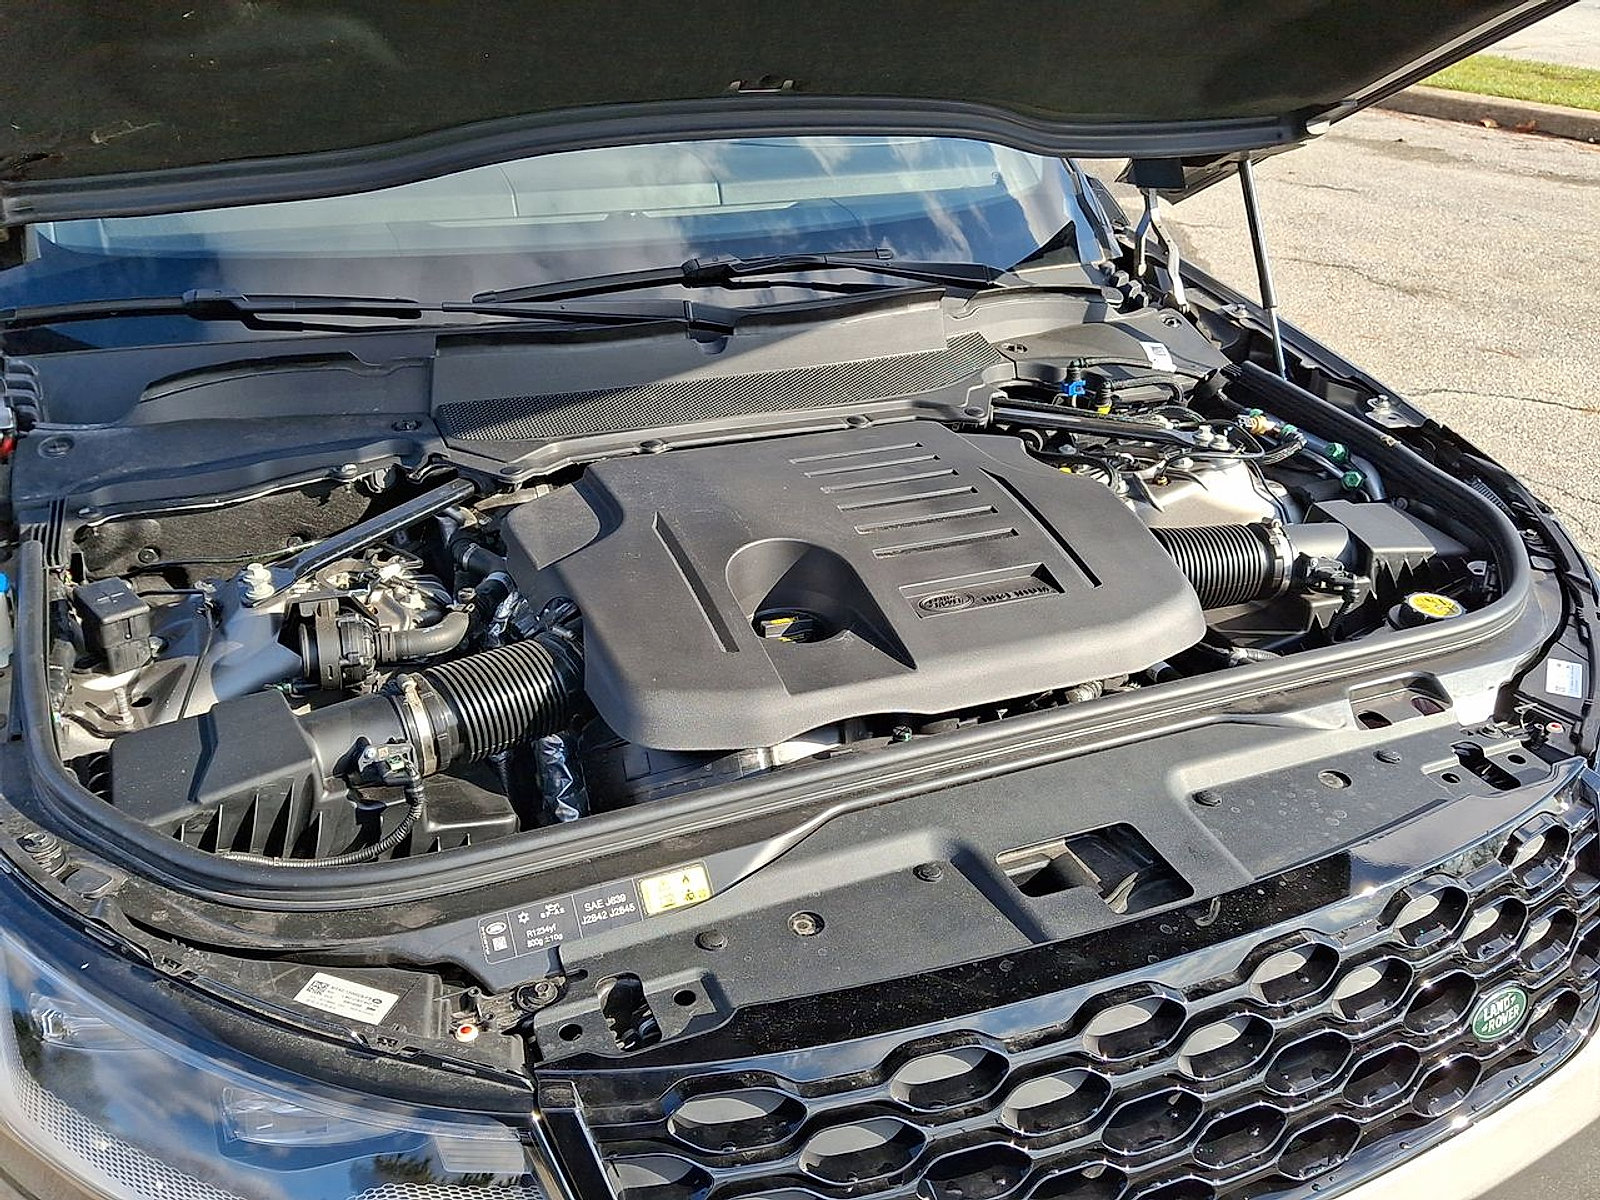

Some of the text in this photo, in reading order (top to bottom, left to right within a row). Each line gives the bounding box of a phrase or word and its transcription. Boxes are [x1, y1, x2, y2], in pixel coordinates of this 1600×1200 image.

[584, 899, 605, 912] SAE
[581, 910, 608, 925] J2842
[526, 923, 557, 938] R1234yf
[1483, 994, 1512, 1022] LAND
[1487, 1003, 1520, 1033] ROVER
